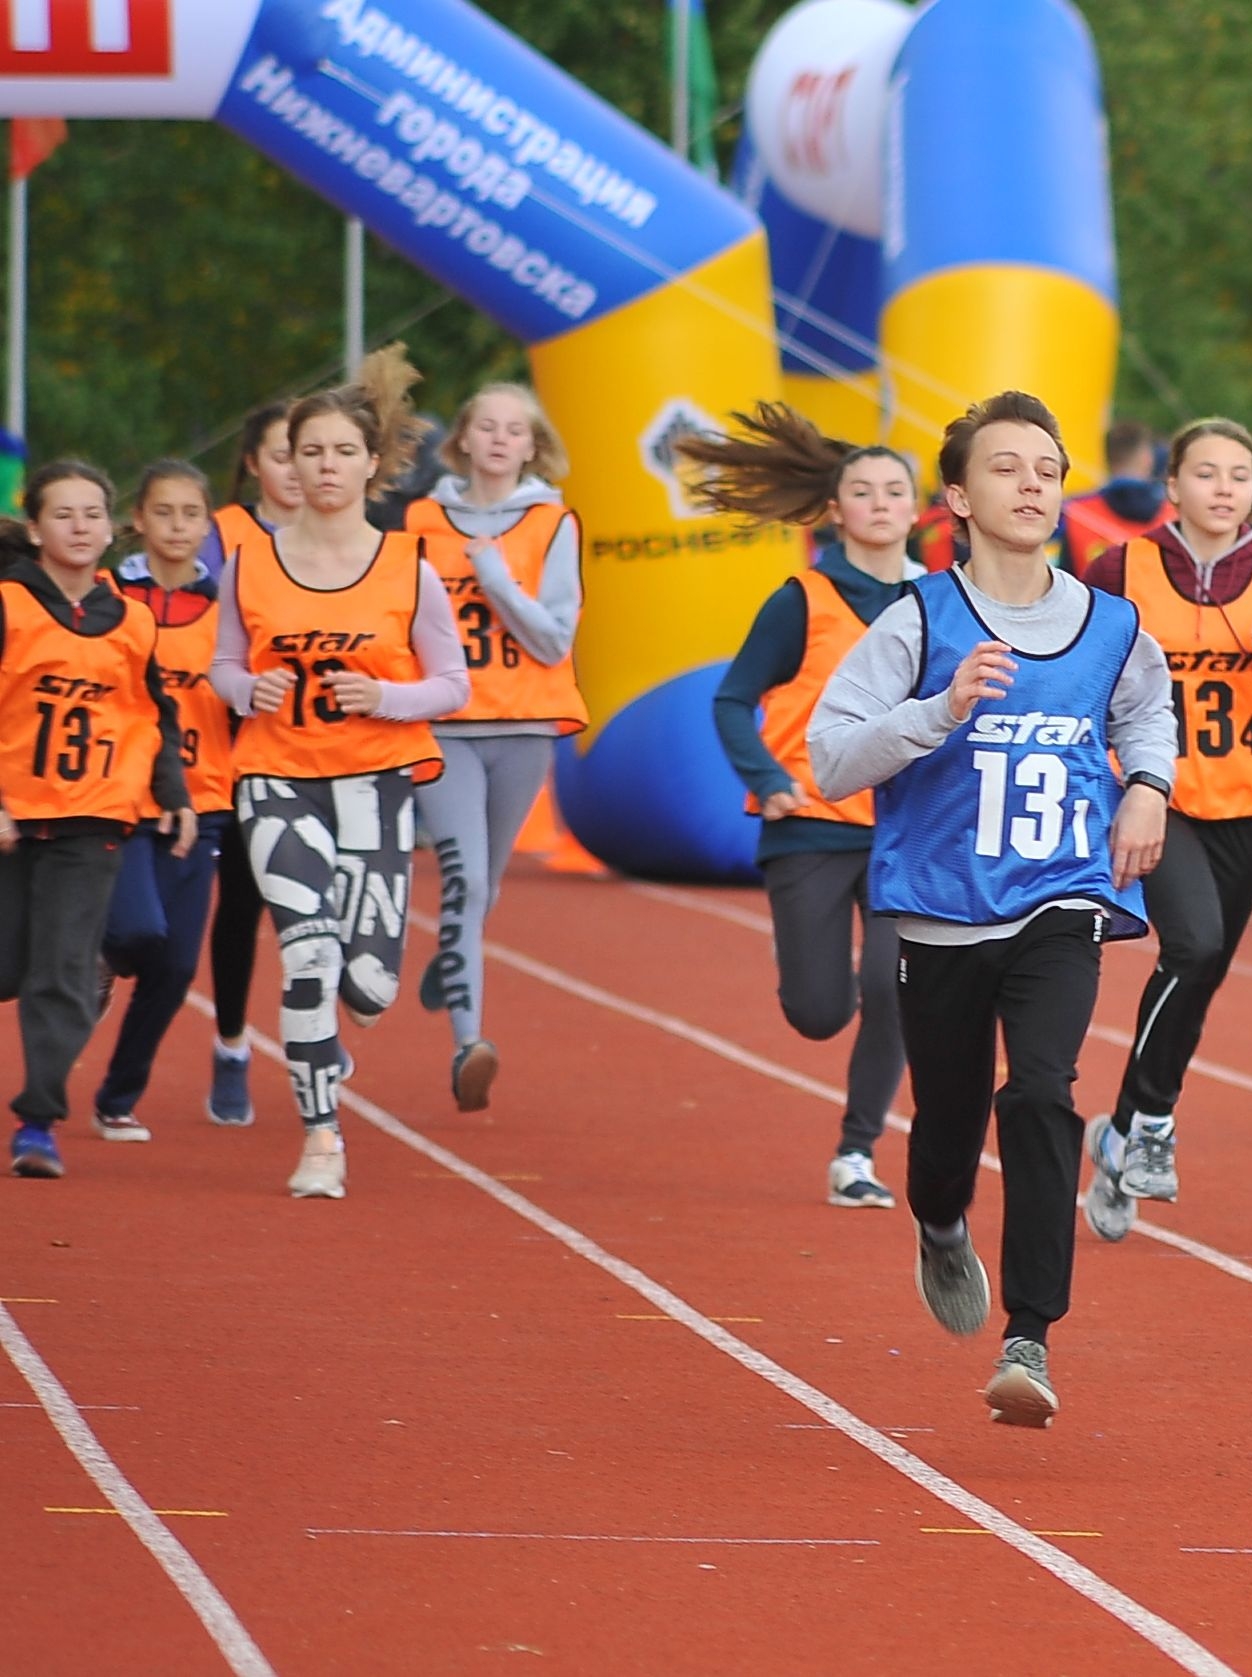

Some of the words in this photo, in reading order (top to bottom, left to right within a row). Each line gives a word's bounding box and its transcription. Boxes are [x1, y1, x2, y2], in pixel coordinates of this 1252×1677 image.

[241, 54, 598, 320] Нижневартовска
[323, 0, 657, 228] Администрация
[377, 92, 532, 210] города
[270, 629, 376, 653] star
